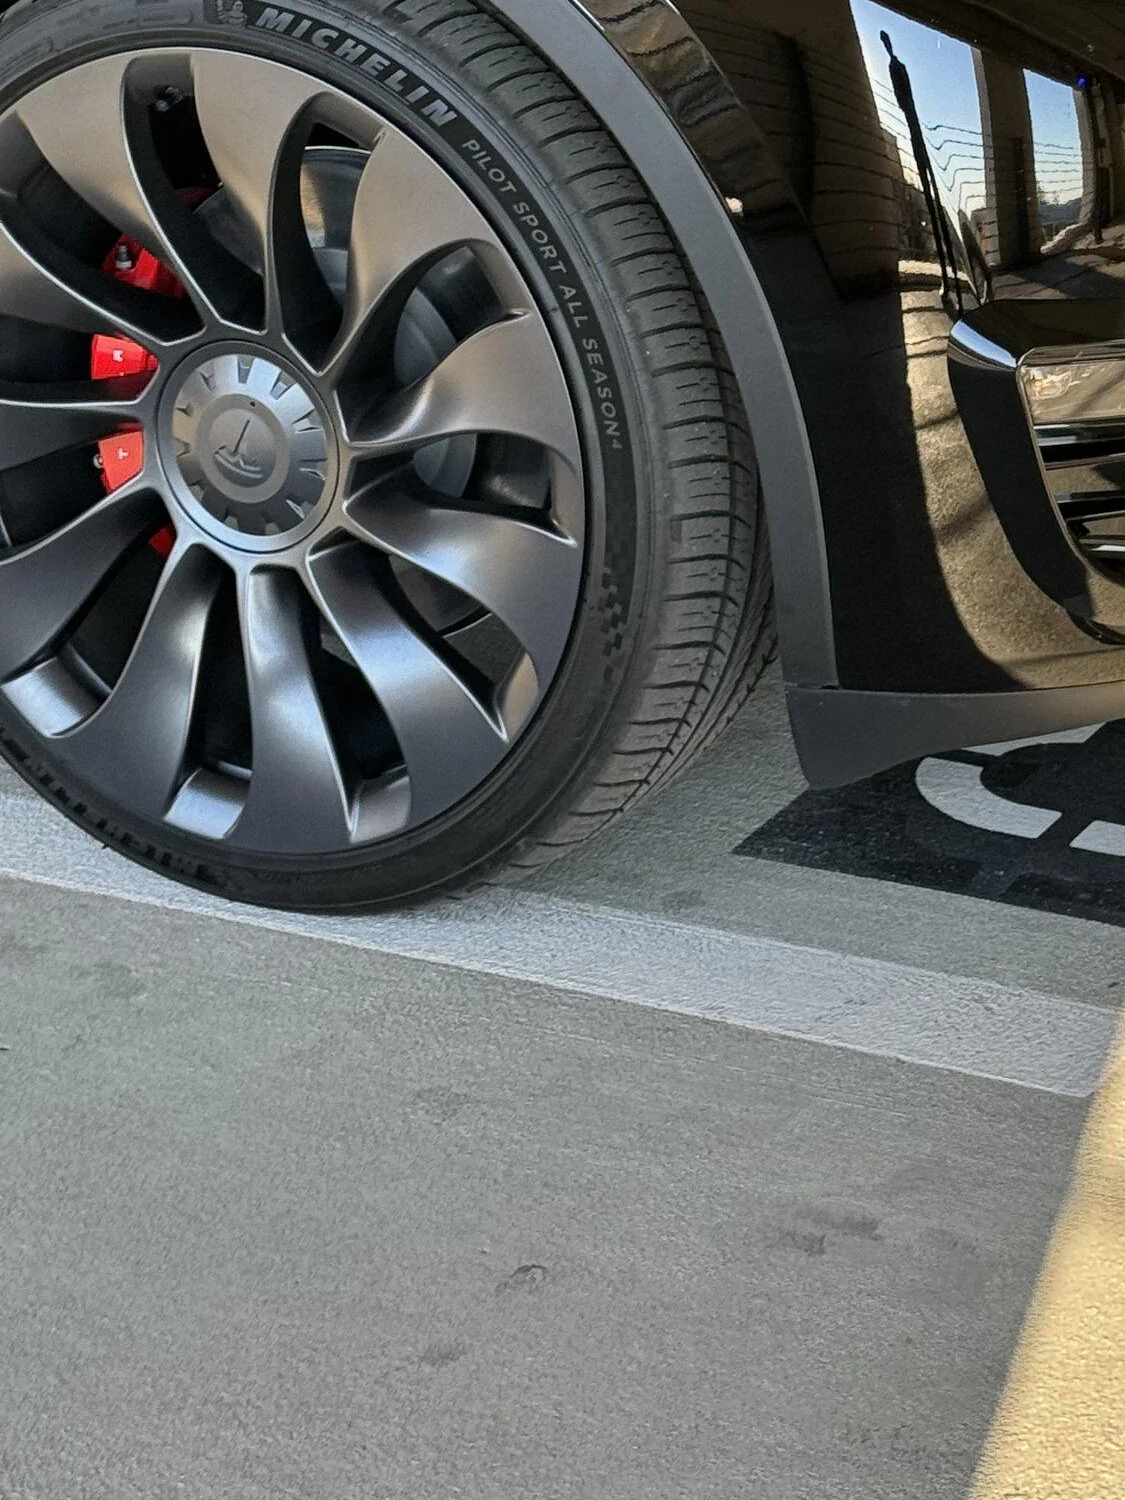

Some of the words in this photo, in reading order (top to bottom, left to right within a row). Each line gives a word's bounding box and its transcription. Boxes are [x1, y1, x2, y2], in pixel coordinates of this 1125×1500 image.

[255, 6, 458, 127] MICHELIN
[462, 139, 517, 194] PILOT
[512, 201, 568, 274] SPORT
[559, 284, 589, 329] ALL
